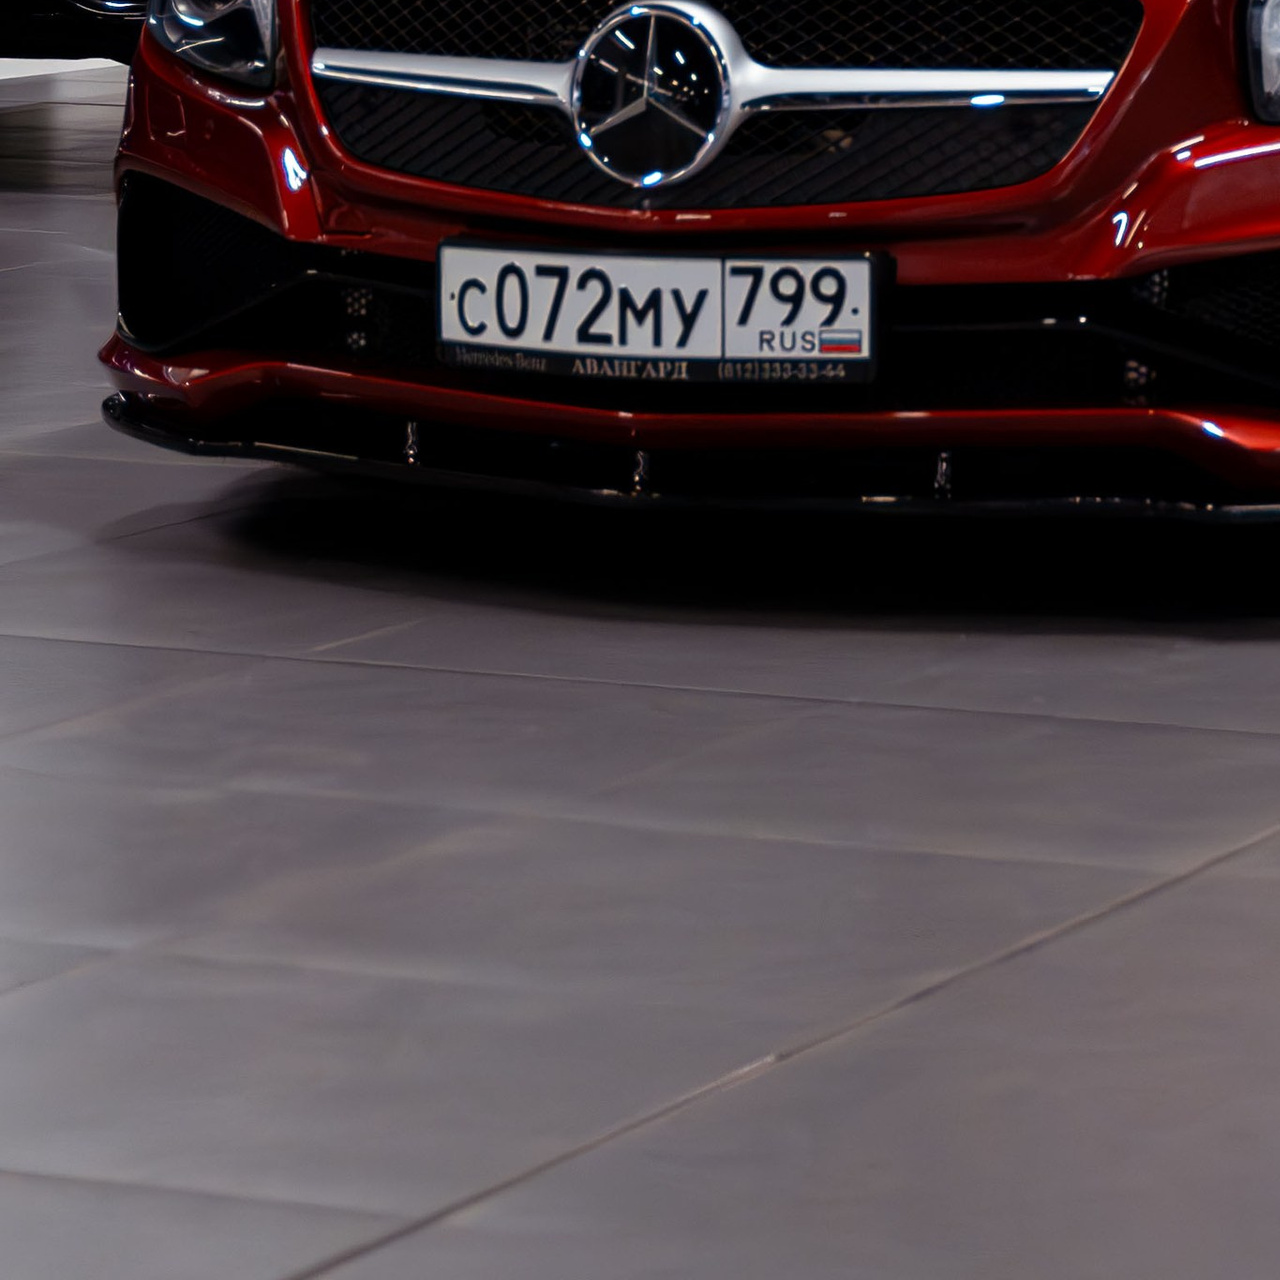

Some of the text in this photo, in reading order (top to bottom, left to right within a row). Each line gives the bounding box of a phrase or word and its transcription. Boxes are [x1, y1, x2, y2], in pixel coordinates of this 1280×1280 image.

[729, 266, 848, 328] 799
[759, 330, 816, 352] RUS
[571, 358, 689, 380] АВАНГАРД
